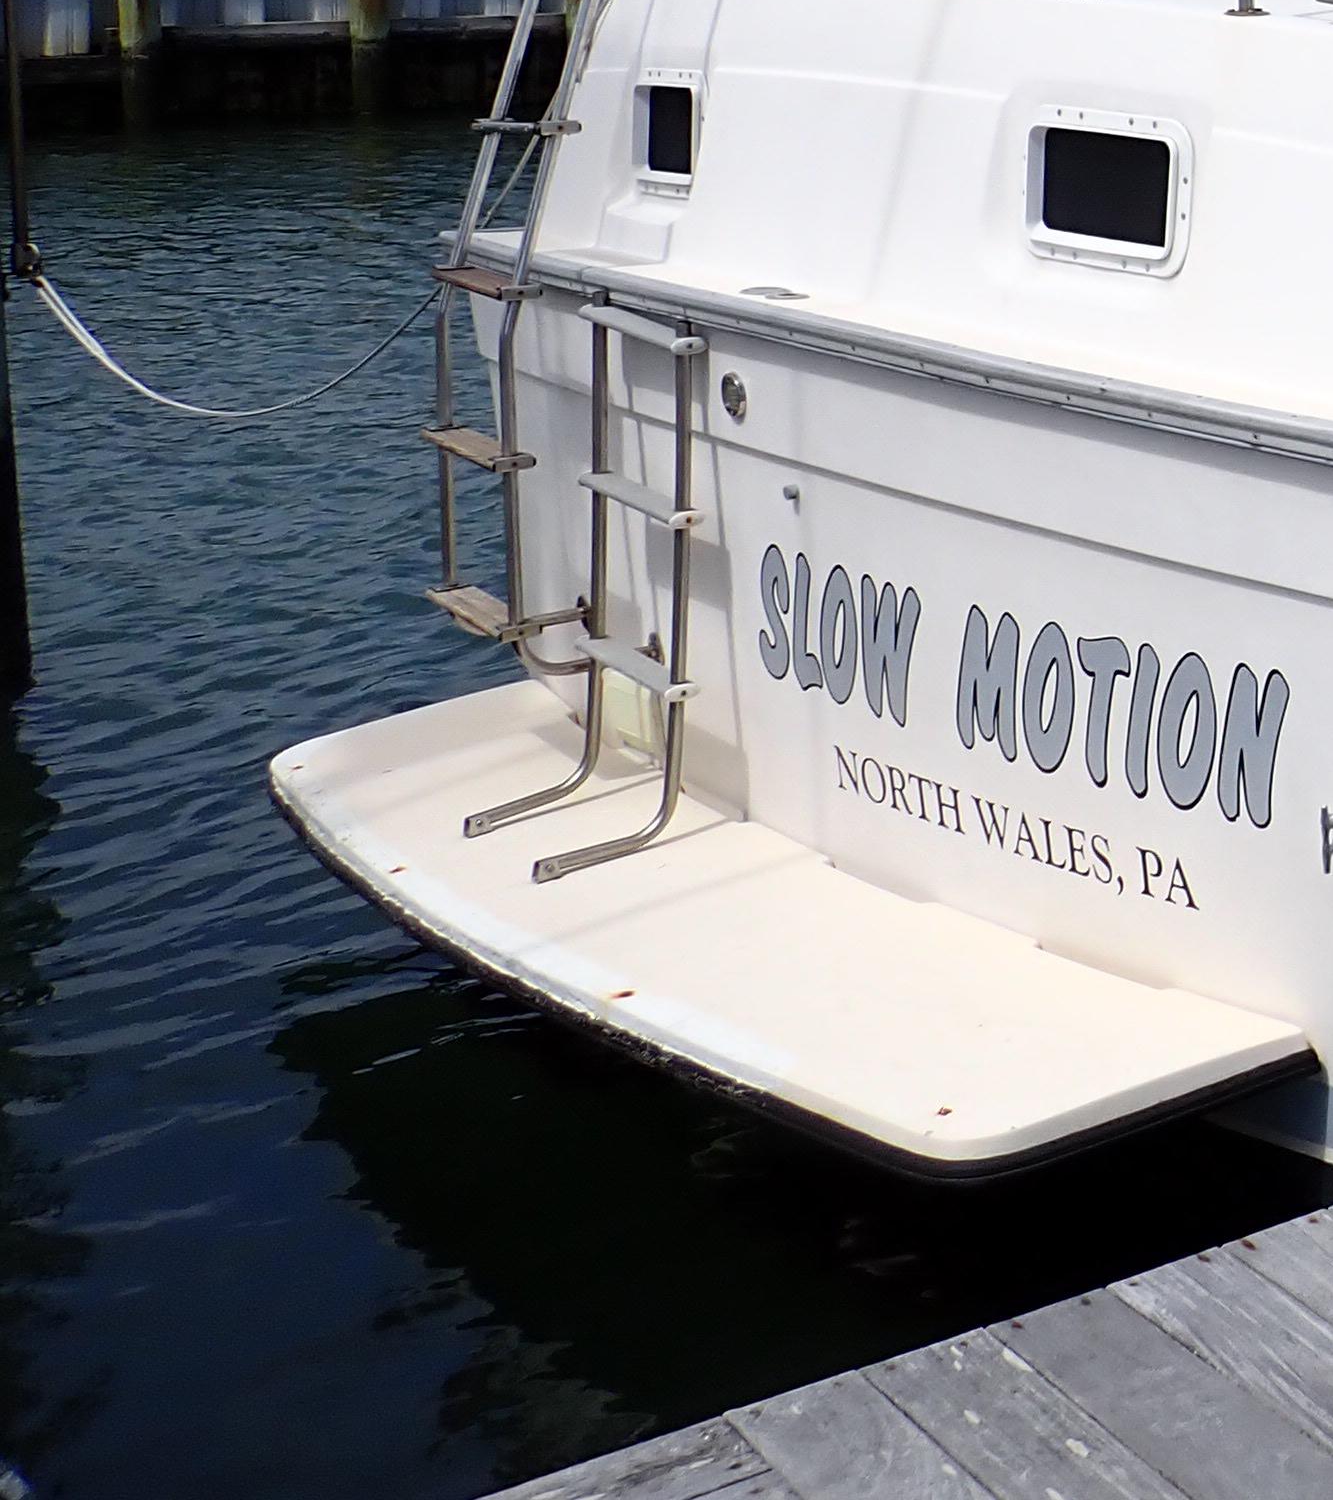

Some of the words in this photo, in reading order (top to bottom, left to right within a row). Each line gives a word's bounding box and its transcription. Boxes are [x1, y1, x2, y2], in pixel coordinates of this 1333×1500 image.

[759, 544, 921, 727] SLOW
[956, 604, 1290, 828] MOTION
[833, 745, 966, 835] NORTH
[971, 794, 1124, 895] WALES,
[1135, 846, 1200, 911] PA
